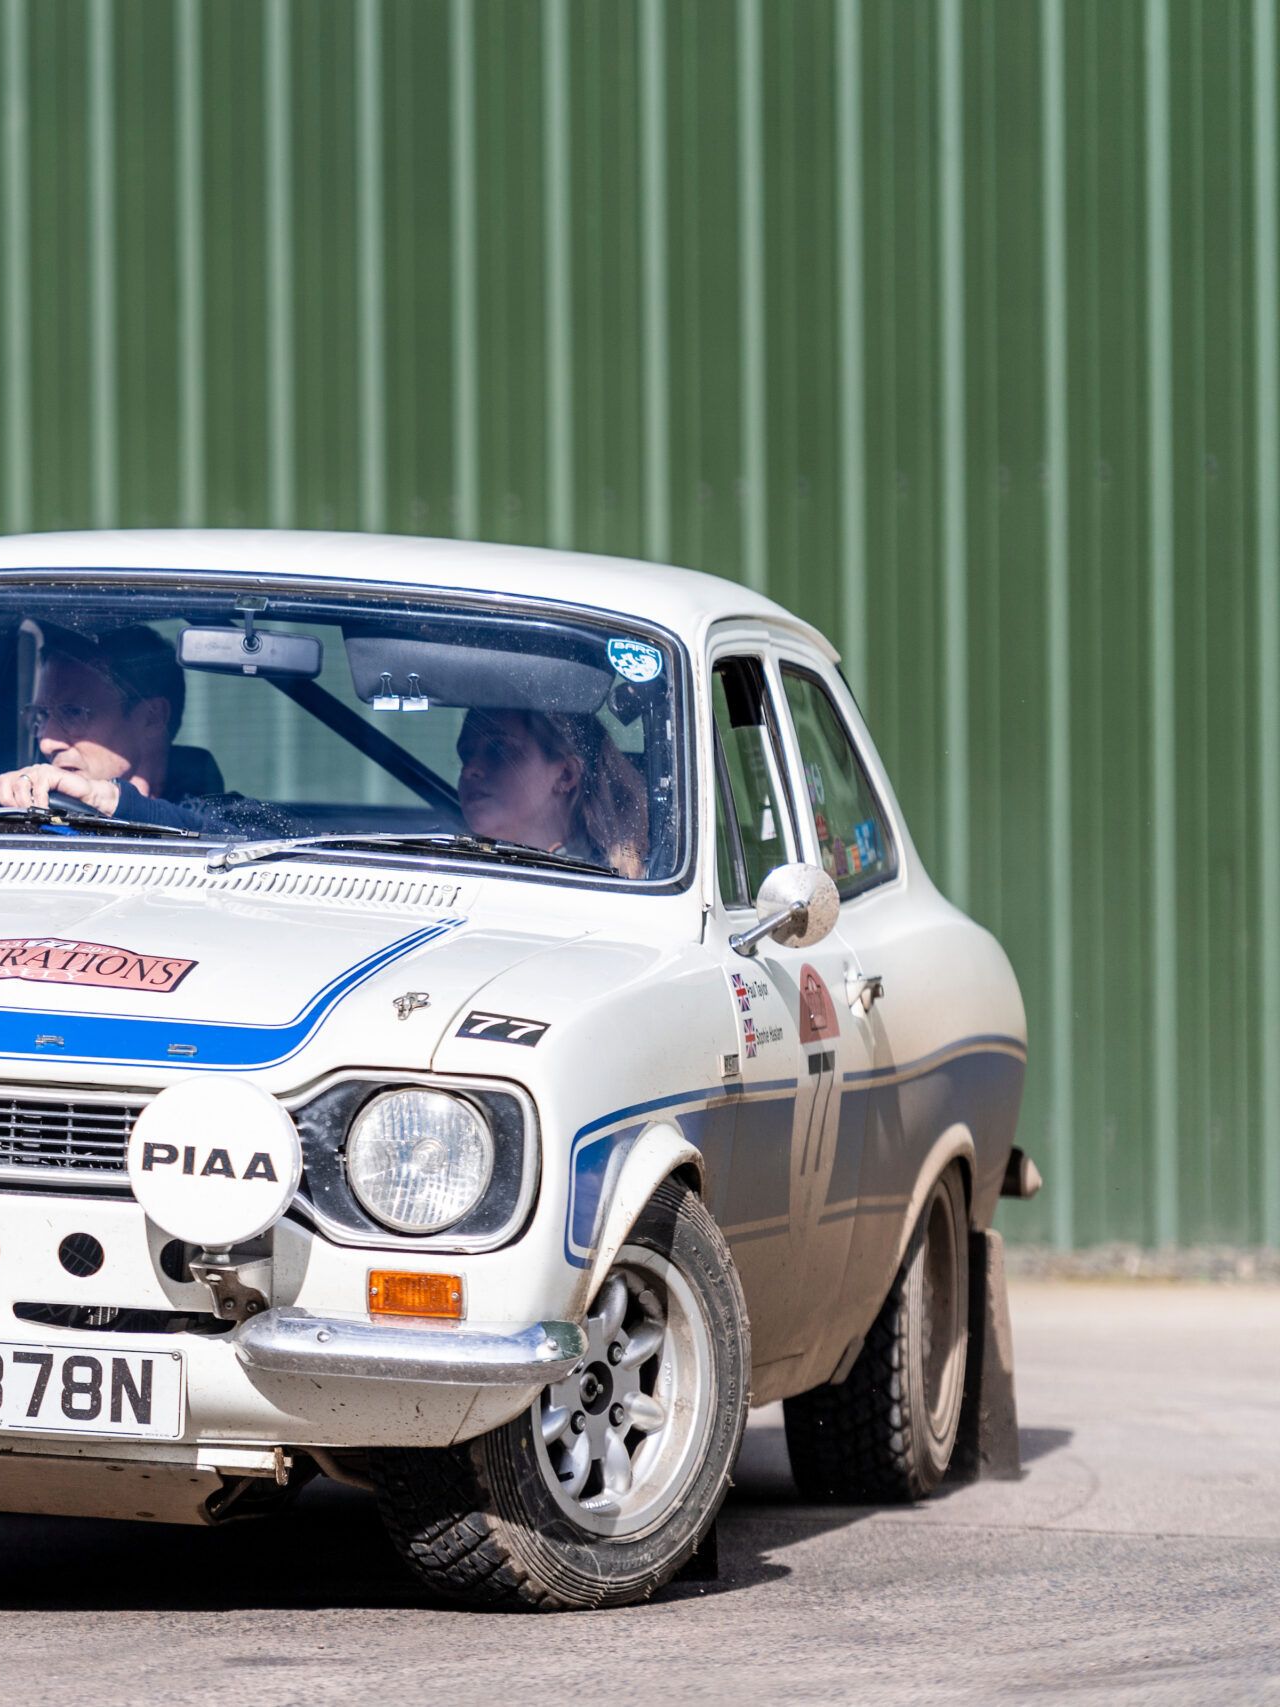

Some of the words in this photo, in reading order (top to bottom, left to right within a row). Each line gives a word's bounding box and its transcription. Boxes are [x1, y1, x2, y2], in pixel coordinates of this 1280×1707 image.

[613, 641, 657, 658] BARC
[468, 1014, 546, 1040] 77
[141, 1142, 279, 1182] PIAA
